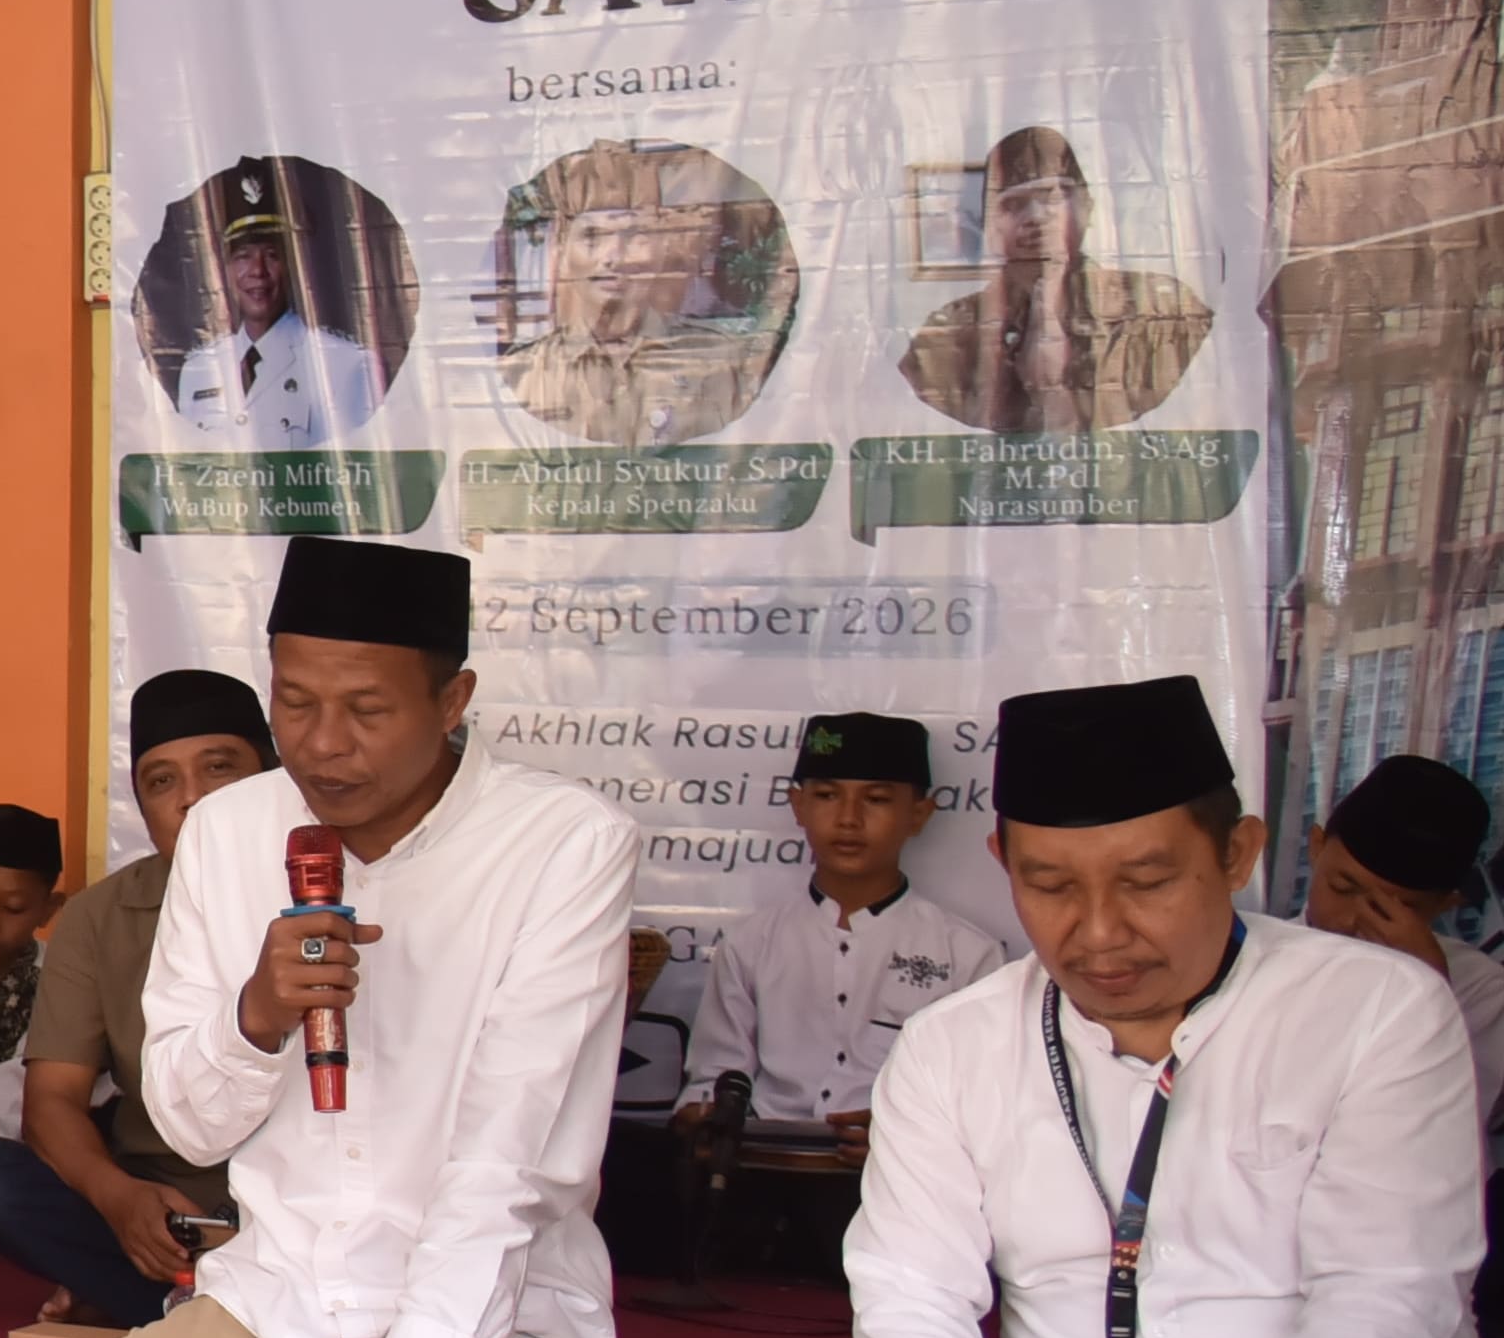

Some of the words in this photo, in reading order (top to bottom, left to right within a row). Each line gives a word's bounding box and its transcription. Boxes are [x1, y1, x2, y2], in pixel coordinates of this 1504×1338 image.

[506, 55, 739, 105] bersama:
[888, 440, 945, 464] KH.
[153, 466, 183, 487] H.
[196, 464, 276, 488] Zaeni
[284, 463, 372, 487] Miftah
[466, 461, 498, 486] H.
[512, 459, 604, 485] Abdul
[162, 496, 250, 523] WaBup
[258, 497, 362, 519] Kebumen
[526, 492, 616, 523] Kepala
[625, 491, 758, 522] Spenzaku
[958, 495, 1140, 518] Narasumber
[532, 594, 821, 646] September
[841, 597, 973, 637] 2026
[496, 713, 656, 748] Akhlak
[673, 716, 806, 750] Rasul
[592, 773, 750, 805] nerasi
